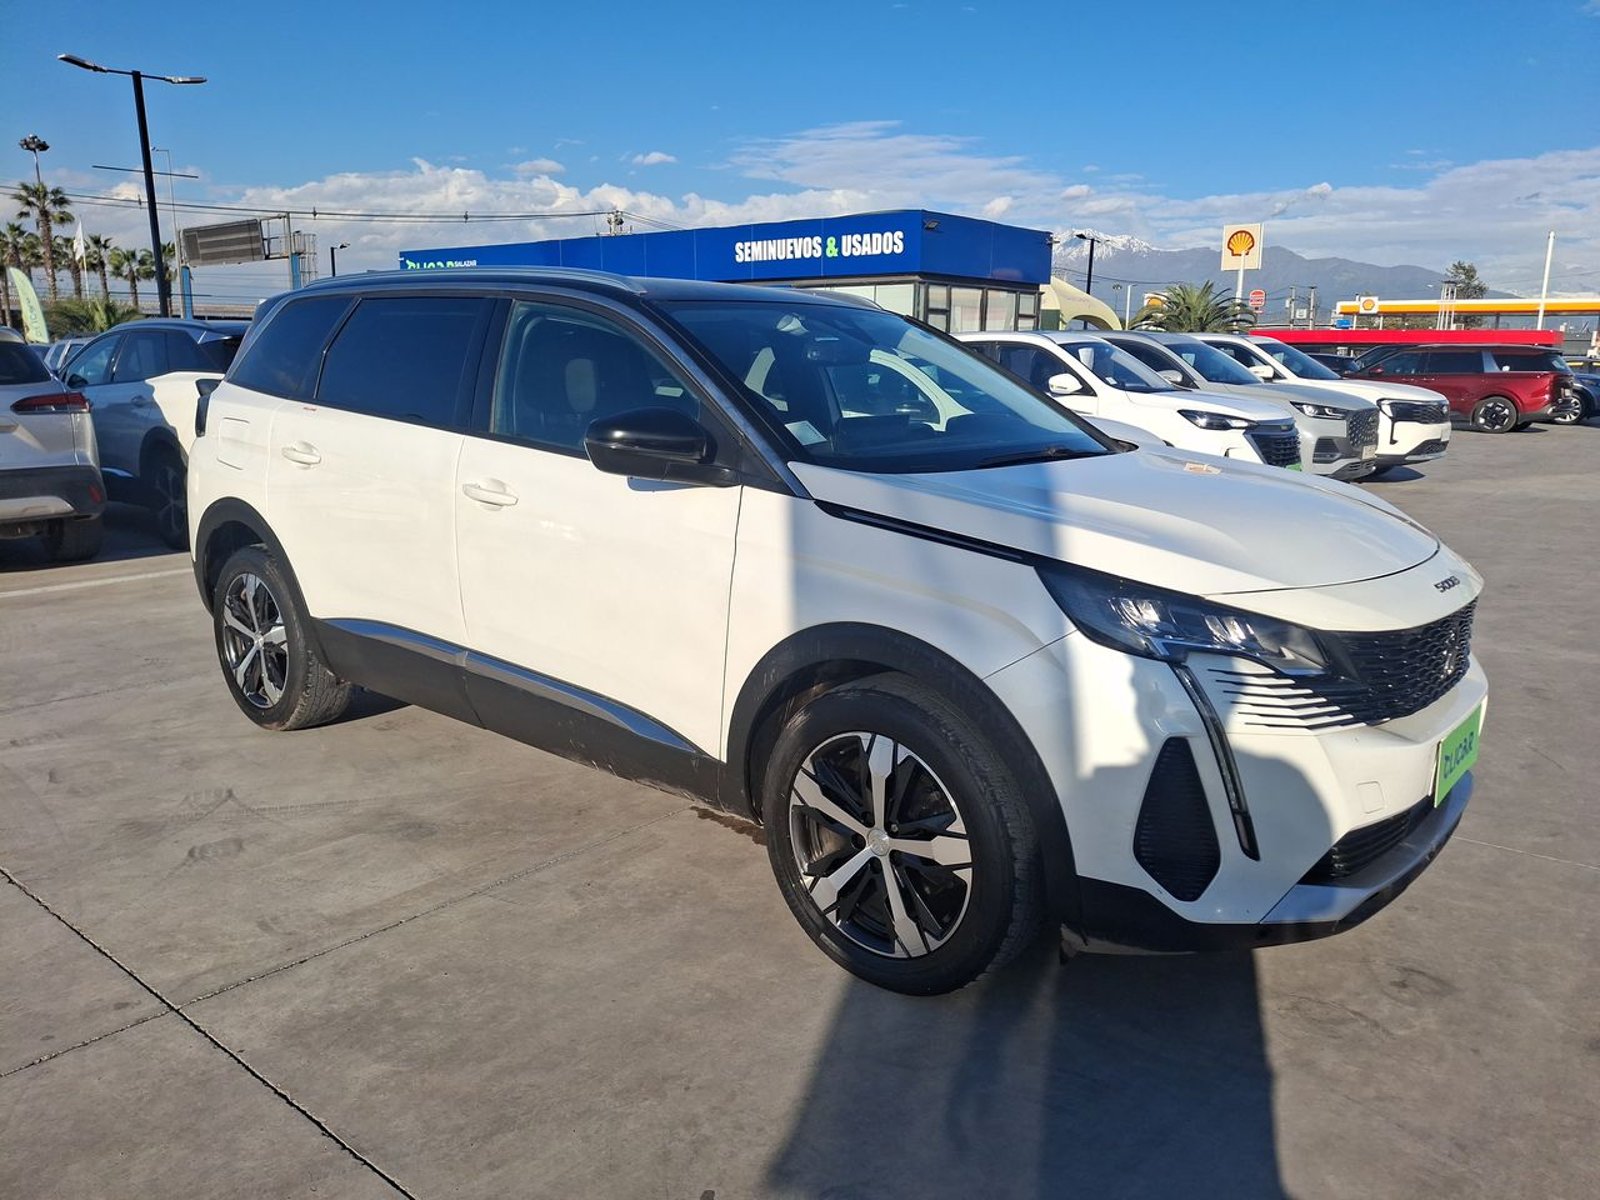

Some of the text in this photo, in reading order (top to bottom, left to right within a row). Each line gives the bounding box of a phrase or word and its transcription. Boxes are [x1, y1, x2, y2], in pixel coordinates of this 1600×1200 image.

[735, 230, 904, 263] SEMINUEVOS & USADOS
[1433, 575, 1460, 593] 5008
